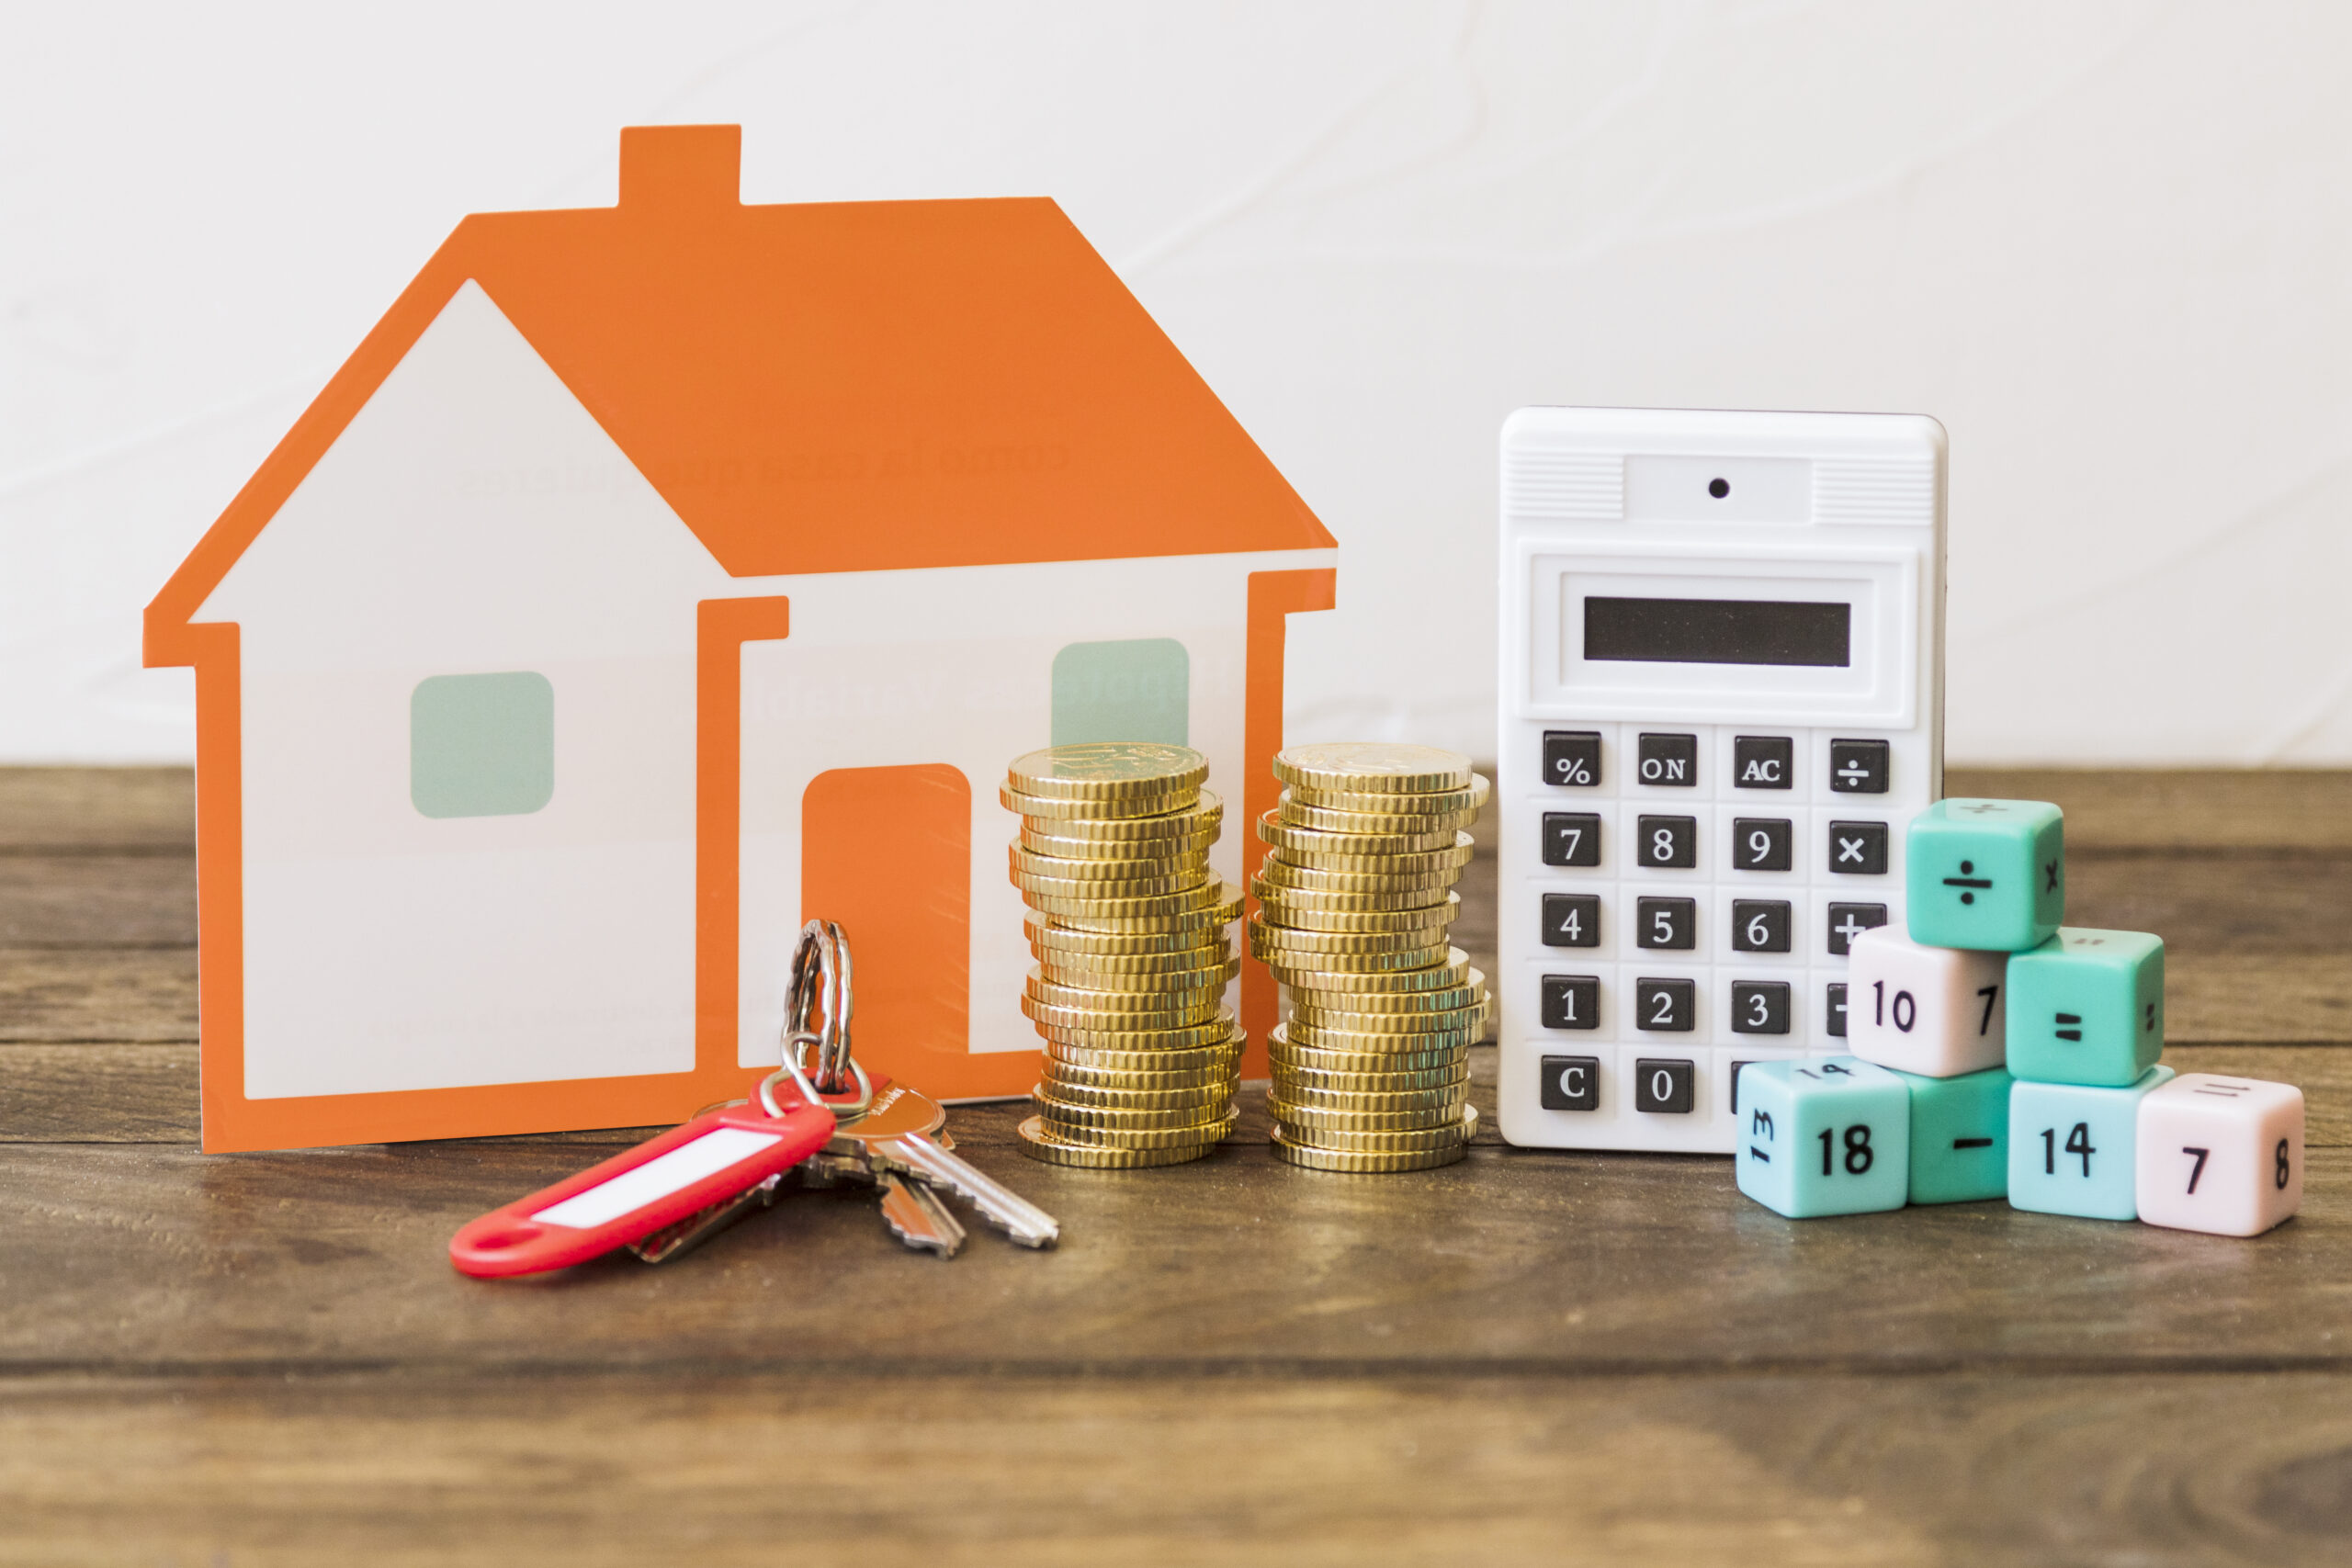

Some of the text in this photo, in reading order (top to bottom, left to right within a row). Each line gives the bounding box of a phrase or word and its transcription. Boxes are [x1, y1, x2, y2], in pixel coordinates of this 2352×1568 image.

[1555, 758, 1590, 784] %
[1641, 758, 1686, 780] ON
[1741, 759, 1781, 782] AC
[1560, 829, 1582, 861] 7
[1653, 829, 1674, 861] 8
[1748, 830, 1771, 863] 9
[1559, 908, 1582, 941] 4
[1653, 911, 1673, 943] 5
[1747, 913, 1770, 946] 6
[1562, 988, 1577, 1021] 1
[1650, 991, 1673, 1023] 2
[1747, 993, 1769, 1027] 3
[1872, 980, 1917, 1033] 10
[1977, 984, 1999, 1036] 7
[1559, 1066, 1585, 1098] C
[1750, 1108, 1774, 1164] 13
[1817, 1123, 1874, 1177] 18
[2040, 1122, 2097, 1179] 14
[2182, 1146, 2210, 1195] 7
[2275, 1137, 2290, 1191] 8
